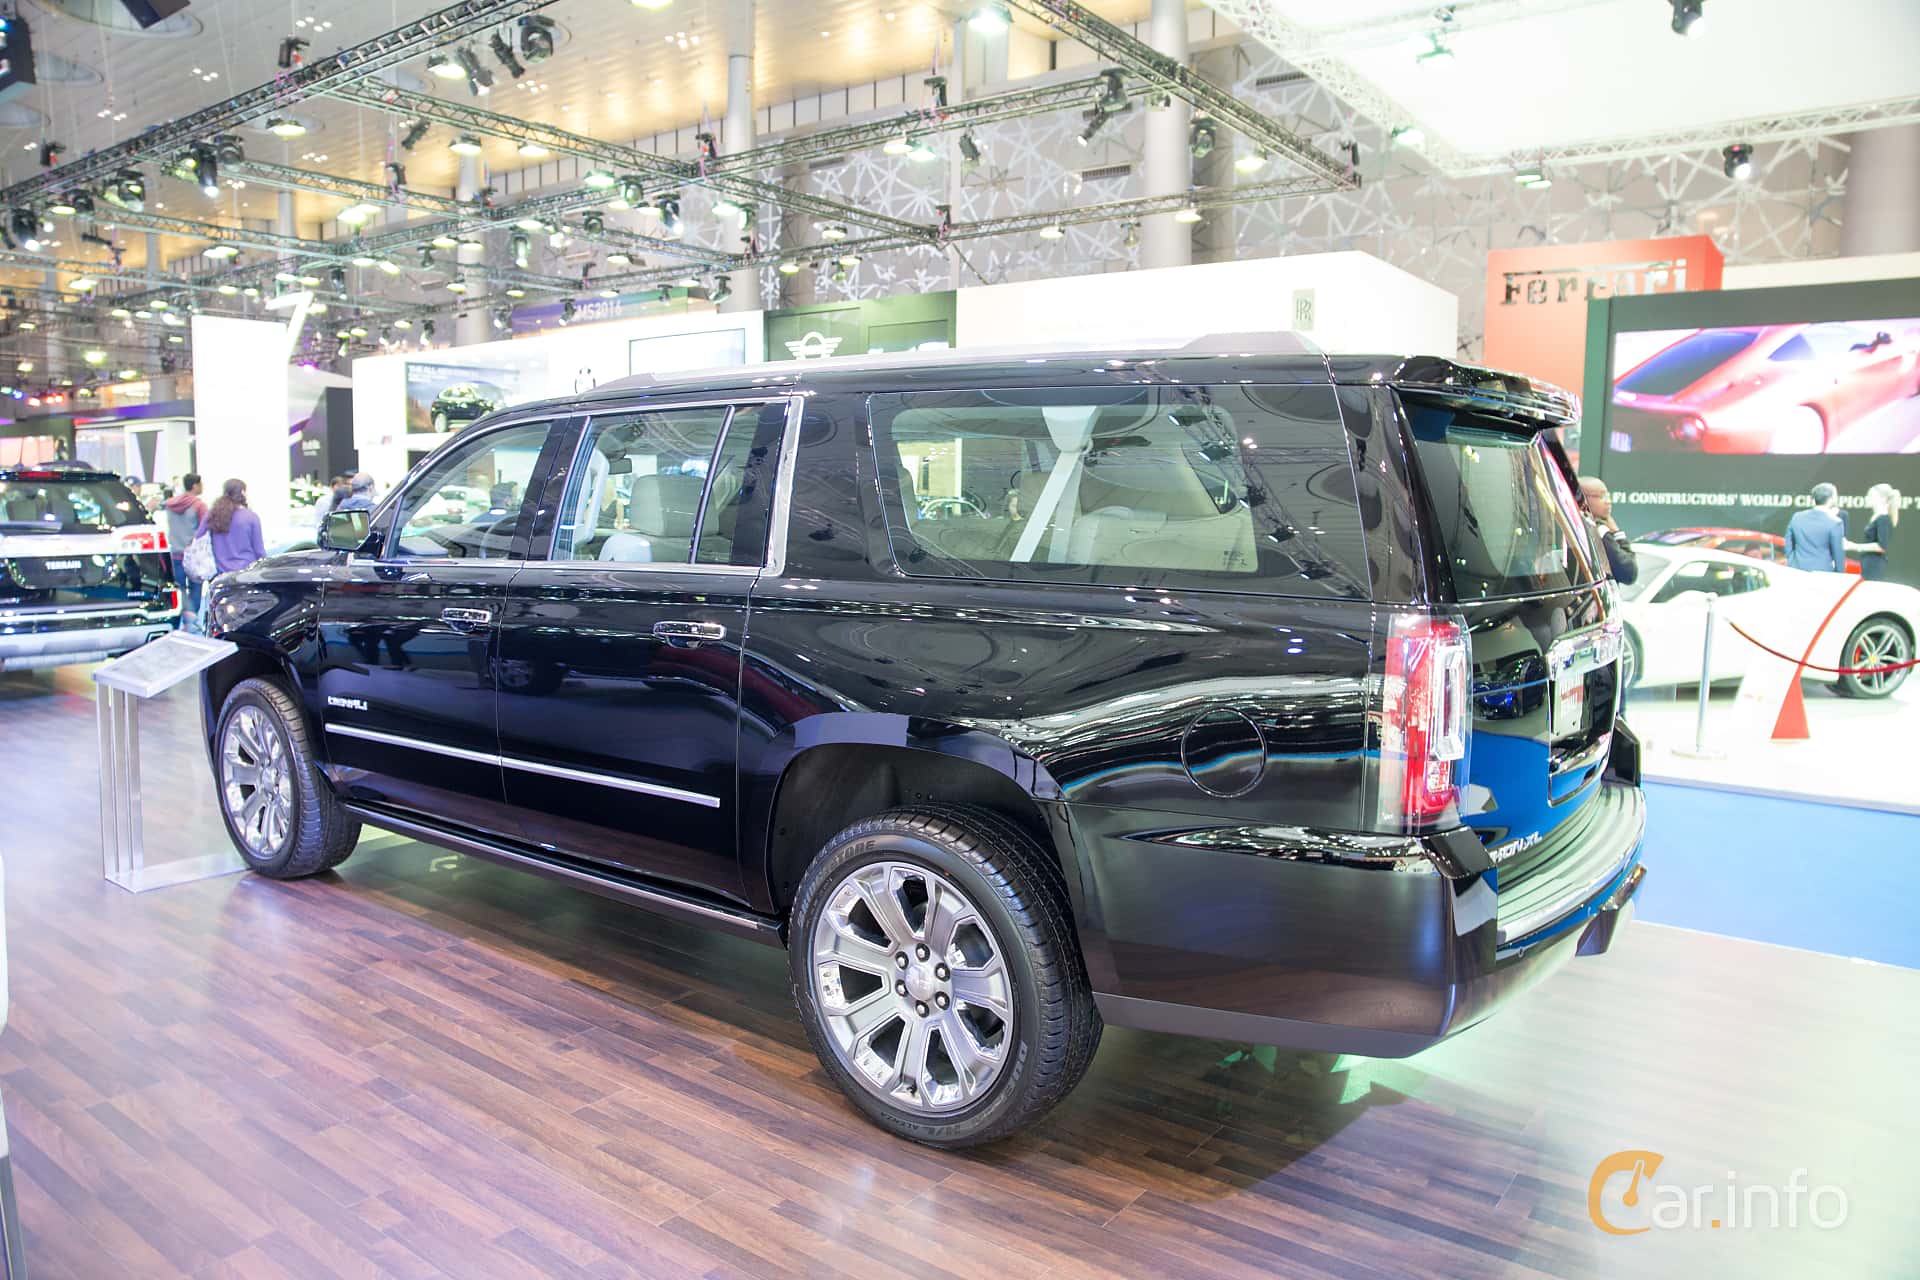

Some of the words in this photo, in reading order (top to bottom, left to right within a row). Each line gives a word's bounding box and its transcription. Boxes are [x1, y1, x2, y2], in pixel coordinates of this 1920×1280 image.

[1500, 258, 1688, 305] Ferrari
[573, 299, 623, 321] MS2016
[1628, 492, 1738, 506] CONSTRUCTORS'
[1739, 494, 1793, 508] WORLD
[46, 560, 82, 570] TERRAIN
[1524, 830, 1543, 850] XL
